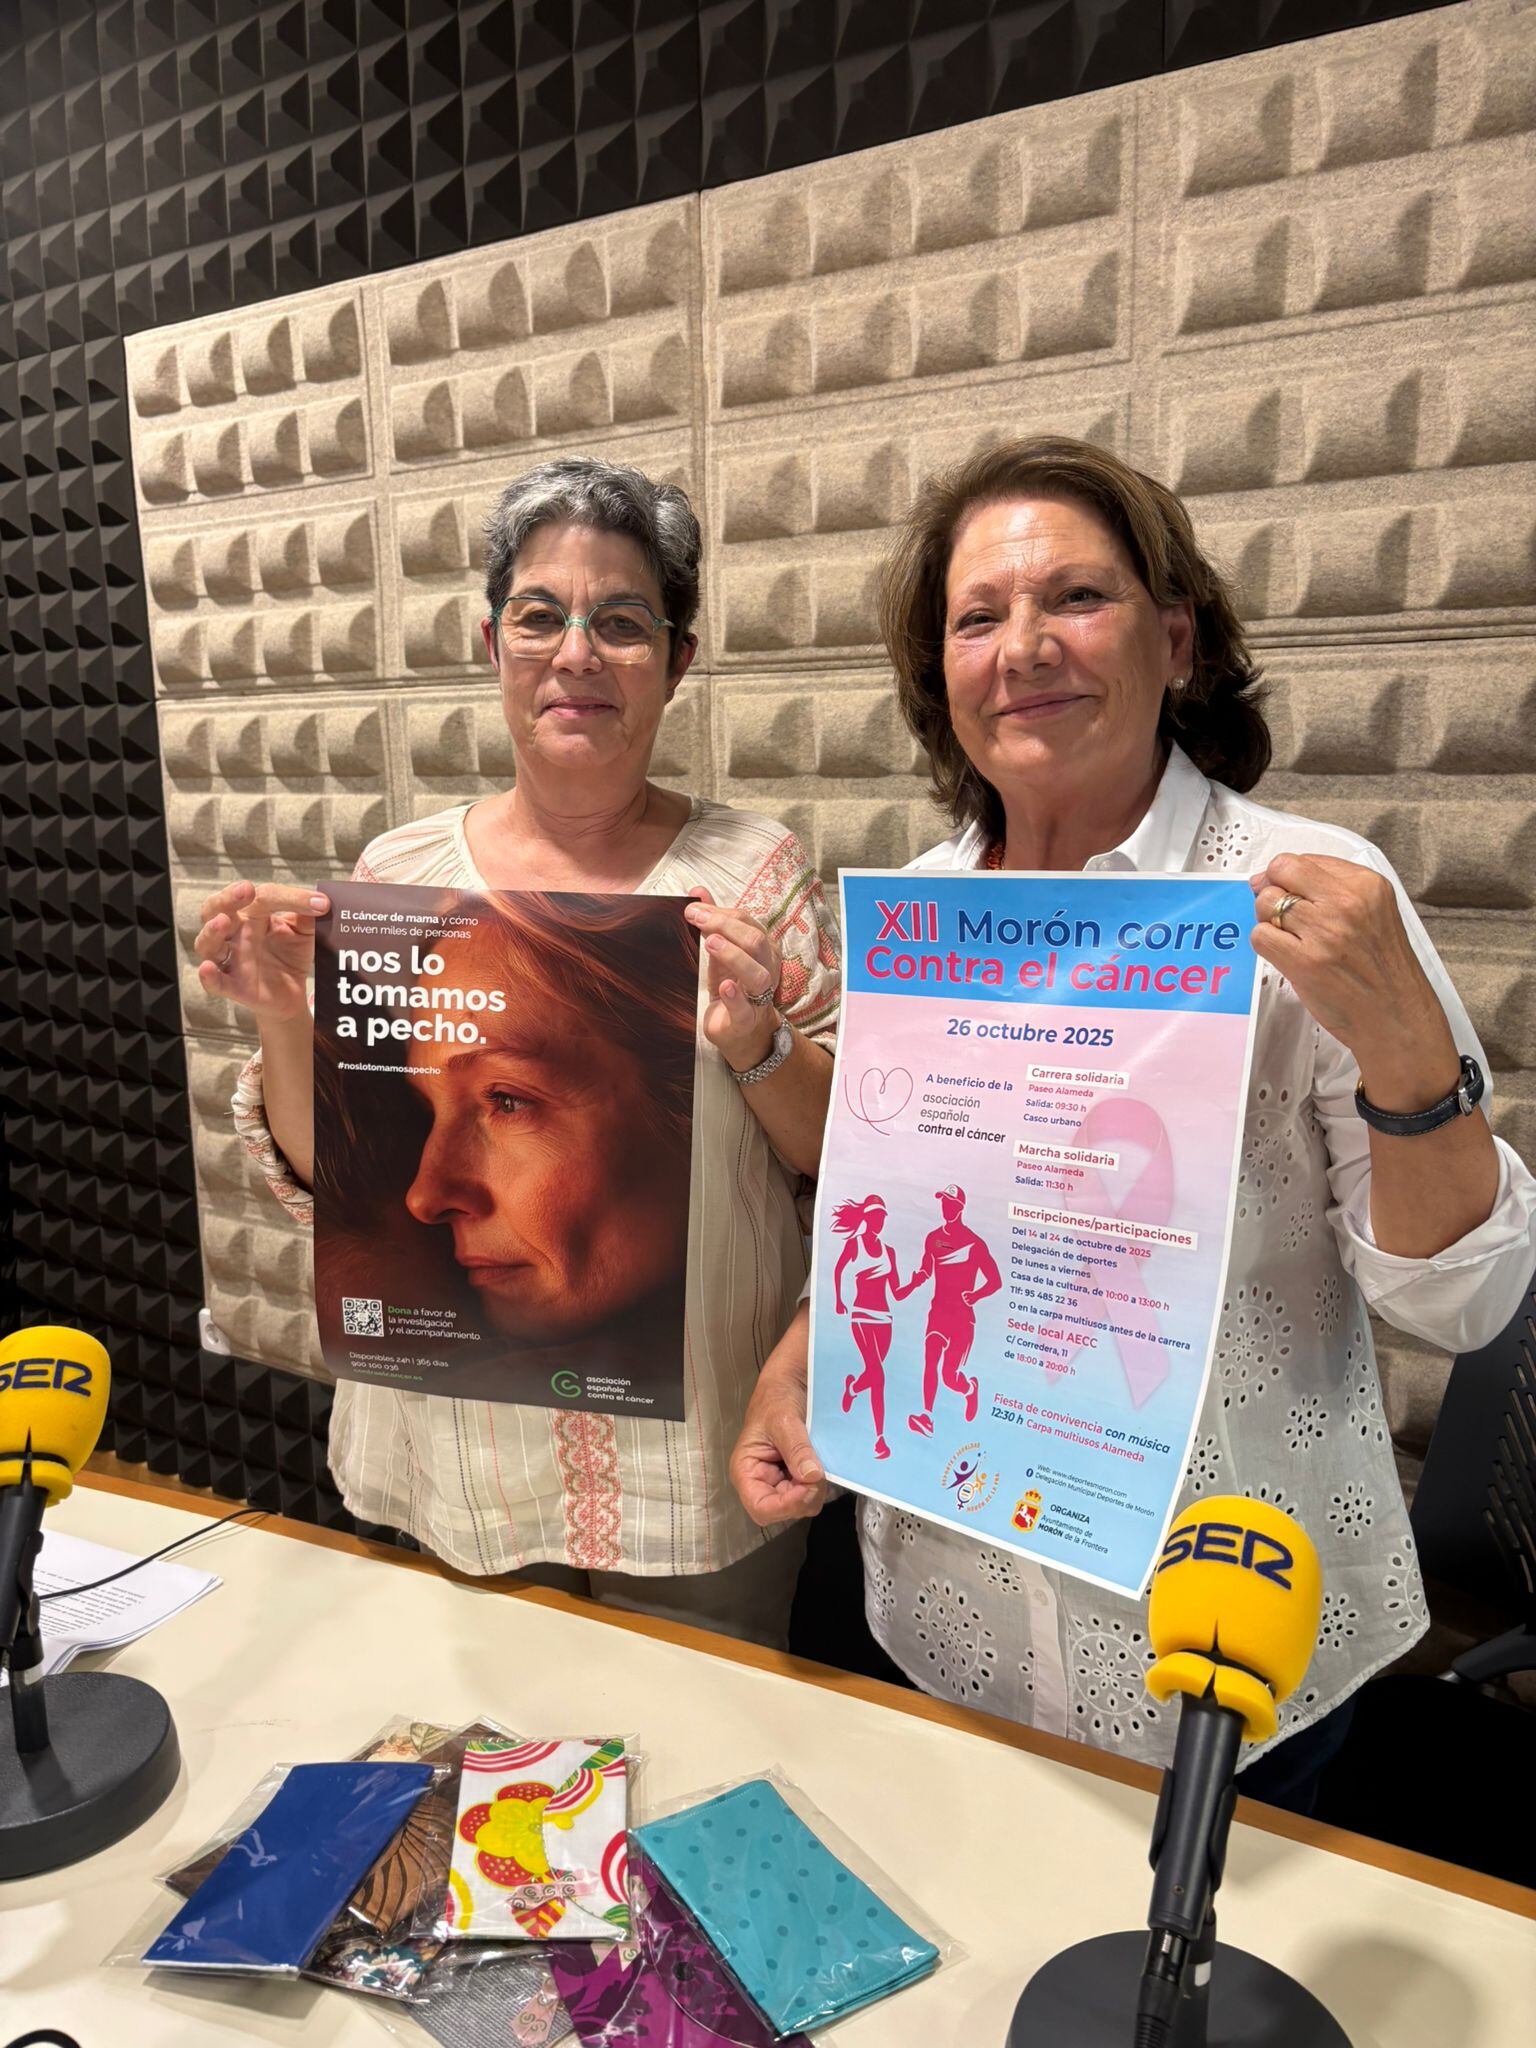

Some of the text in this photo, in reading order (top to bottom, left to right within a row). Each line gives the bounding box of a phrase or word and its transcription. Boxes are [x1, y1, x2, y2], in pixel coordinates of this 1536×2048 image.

[341, 910, 479, 926] El cáncer de mama y cómo
[875, 900, 1241, 951] XII Morón corre
[340, 924, 471, 939] lo viven miles de personas
[339, 945, 445, 976] nos lo
[865, 945, 1233, 995] Contra el cáncer
[337, 977, 507, 1012] tomamos
[336, 1014, 487, 1047] a pecho.
[947, 1018, 1114, 1047] 26 octubre 2025
[338, 1062, 441, 1075] #noslotomamosapecho
[1032, 1068, 1125, 1085] Carrera solidaria
[926, 1073, 1013, 1091] A beneficio de la
[1028, 1084, 1094, 1098] Paseo Alameda
[922, 1094, 981, 1108] asociación
[1026, 1099, 1054, 1109] Salida:
[1055, 1102, 1079, 1112] 09:30
[920, 1108, 970, 1122] española
[1023, 1113, 1082, 1127] Casco urbano
[917, 1123, 1006, 1143] contra el cáncer
[1018, 1144, 1115, 1166] Marcha solidaria
[1017, 1160, 1085, 1177] Paseo Alameda
[1015, 1176, 1074, 1191] Salida: 11:30 h
[1013, 1206, 1192, 1245] Inscripciones/participaciones
[1012, 1226, 1151, 1258] Del 14 al 24 de octubre de 2025
[1011, 1241, 1118, 1268] Delegación de deportes
[1011, 1256, 1024, 1265] De
[1025, 1258, 1049, 1270] lunes
[1058, 1266, 1091, 1279] viernes
[1010, 1271, 1170, 1311] Casa de la cultura, de 10:00 a 13:00 h
[1024, 1288, 1035, 1298] 95
[1037, 1291, 1054, 1302] 485
[1055, 1295, 1065, 1304] 22
[1066, 1297, 1078, 1307] 36
[387, 1306, 412, 1315] Dona
[421, 1307, 443, 1317] favor
[444, 1309, 457, 1319] de
[388, 1316, 453, 1329] la investigación
[389, 1327, 394, 1335] y
[1007, 1318, 1098, 1348] Sede local AECC
[1009, 1301, 1191, 1350] O en la carpa multiusos antes de la carrera
[1006, 1335, 1068, 1358] C/ Corredera, 11
[1004, 1350, 1015, 1359] de
[1016, 1352, 1037, 1365] 18:00
[1045, 1360, 1069, 1374] 20:00
[1070, 1367, 1076, 1375] h
[586, 1376, 631, 1386] asociación
[587, 1384, 625, 1394] española
[587, 1392, 615, 1400] contra
[625, 1395, 655, 1405] cáncer
[991, 1406, 1145, 1463] 12:30 h Carpa multiusos Alameda
[994, 1392, 1171, 1455] Fiesta de convivencia con música
[1035, 1472, 1155, 1518] Delegación Municipal Deportes de Morón
[1050, 1504, 1090, 1525] ORGANIZA
[1041, 1514, 1093, 1538] Ayuntamiento de
[1038, 1523, 1109, 1554] MORÓN de la Frontera
[1156, 1522, 1294, 1591] SER
